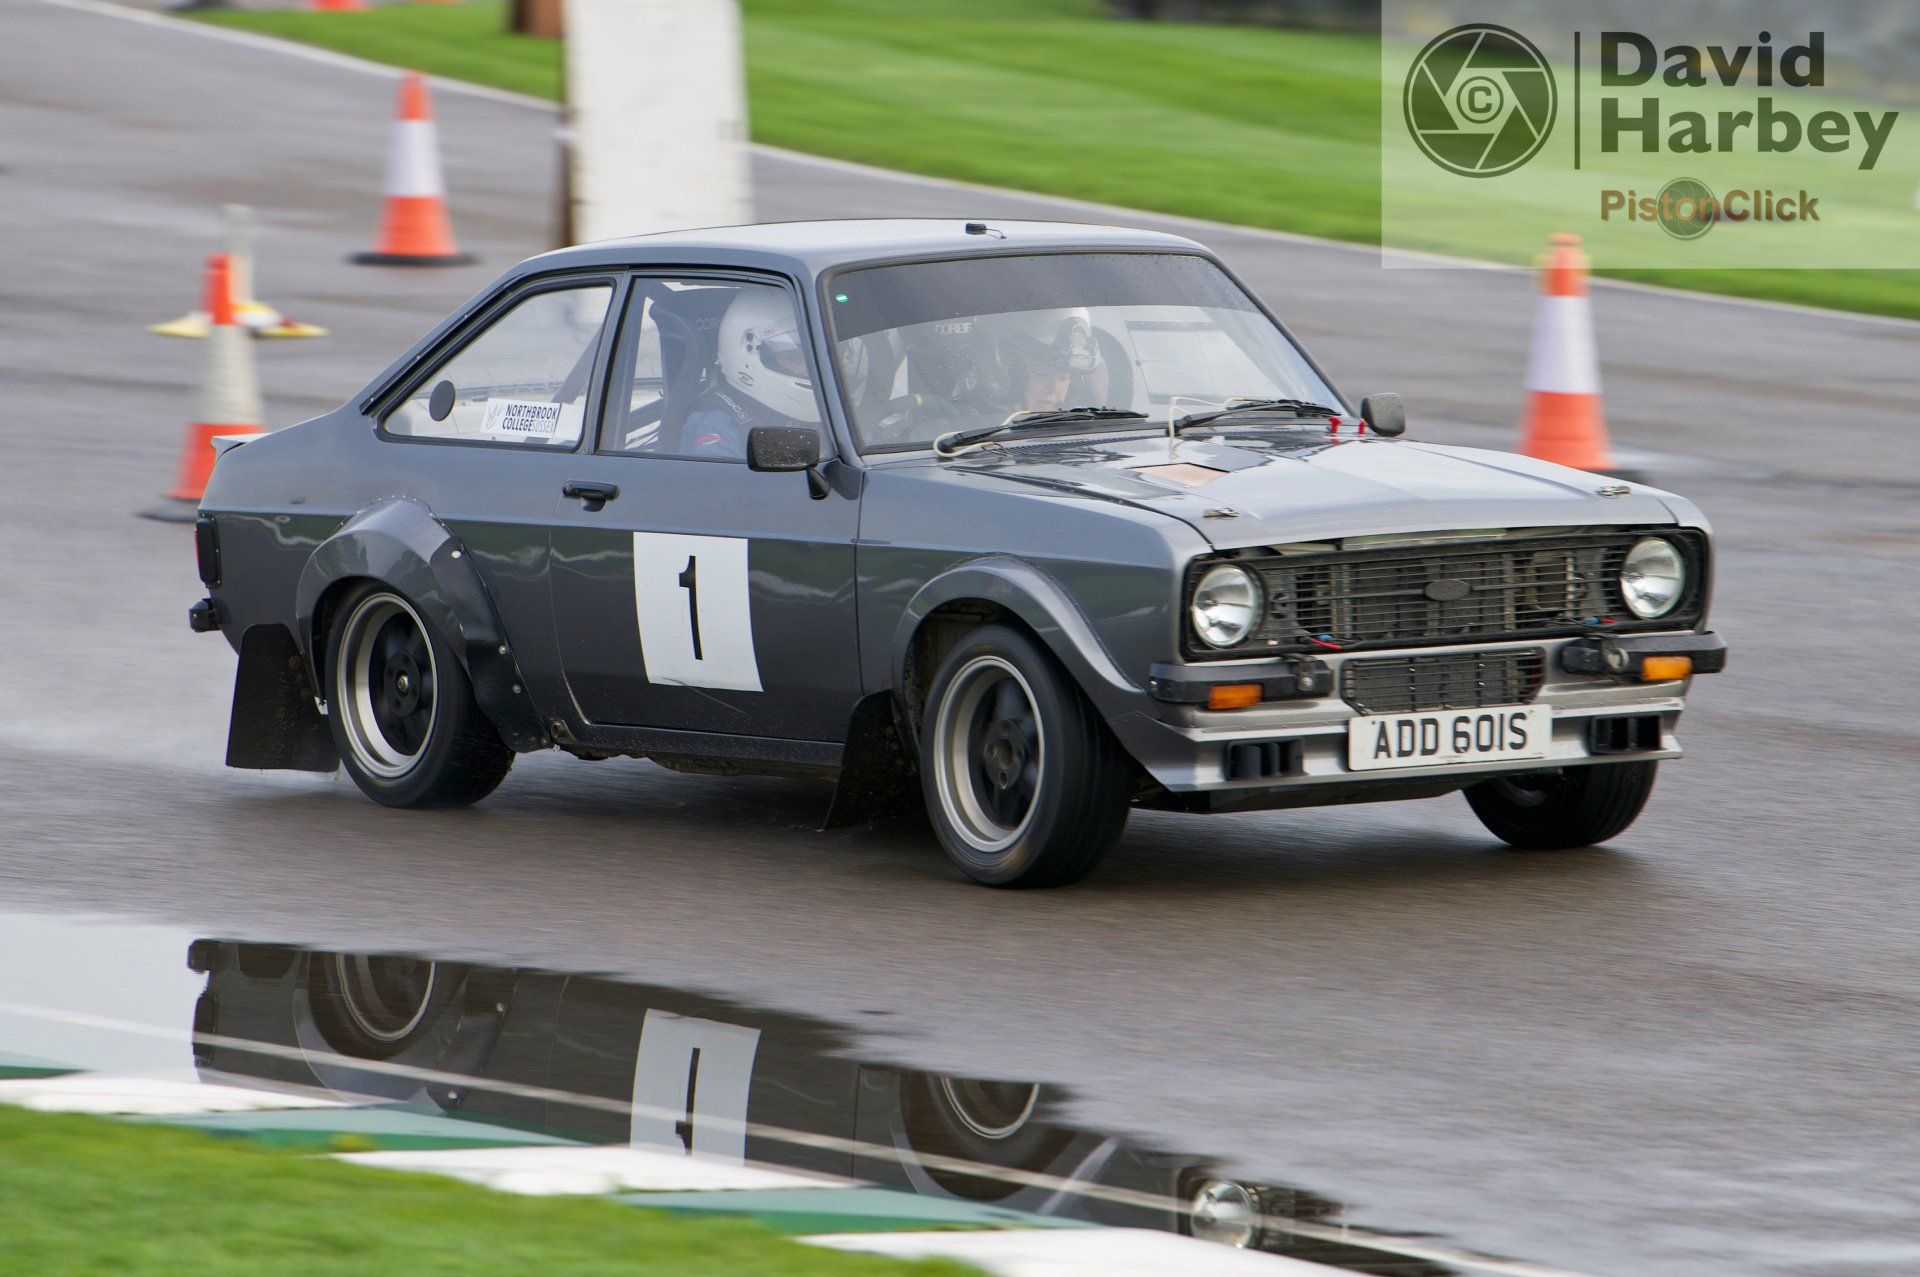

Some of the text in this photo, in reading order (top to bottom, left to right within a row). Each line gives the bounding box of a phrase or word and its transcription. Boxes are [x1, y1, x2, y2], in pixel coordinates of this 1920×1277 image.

[506, 404, 558, 419] NORTHBROOK
[678, 554, 704, 661] 1
[1374, 712, 1527, 760] ADD 601S
